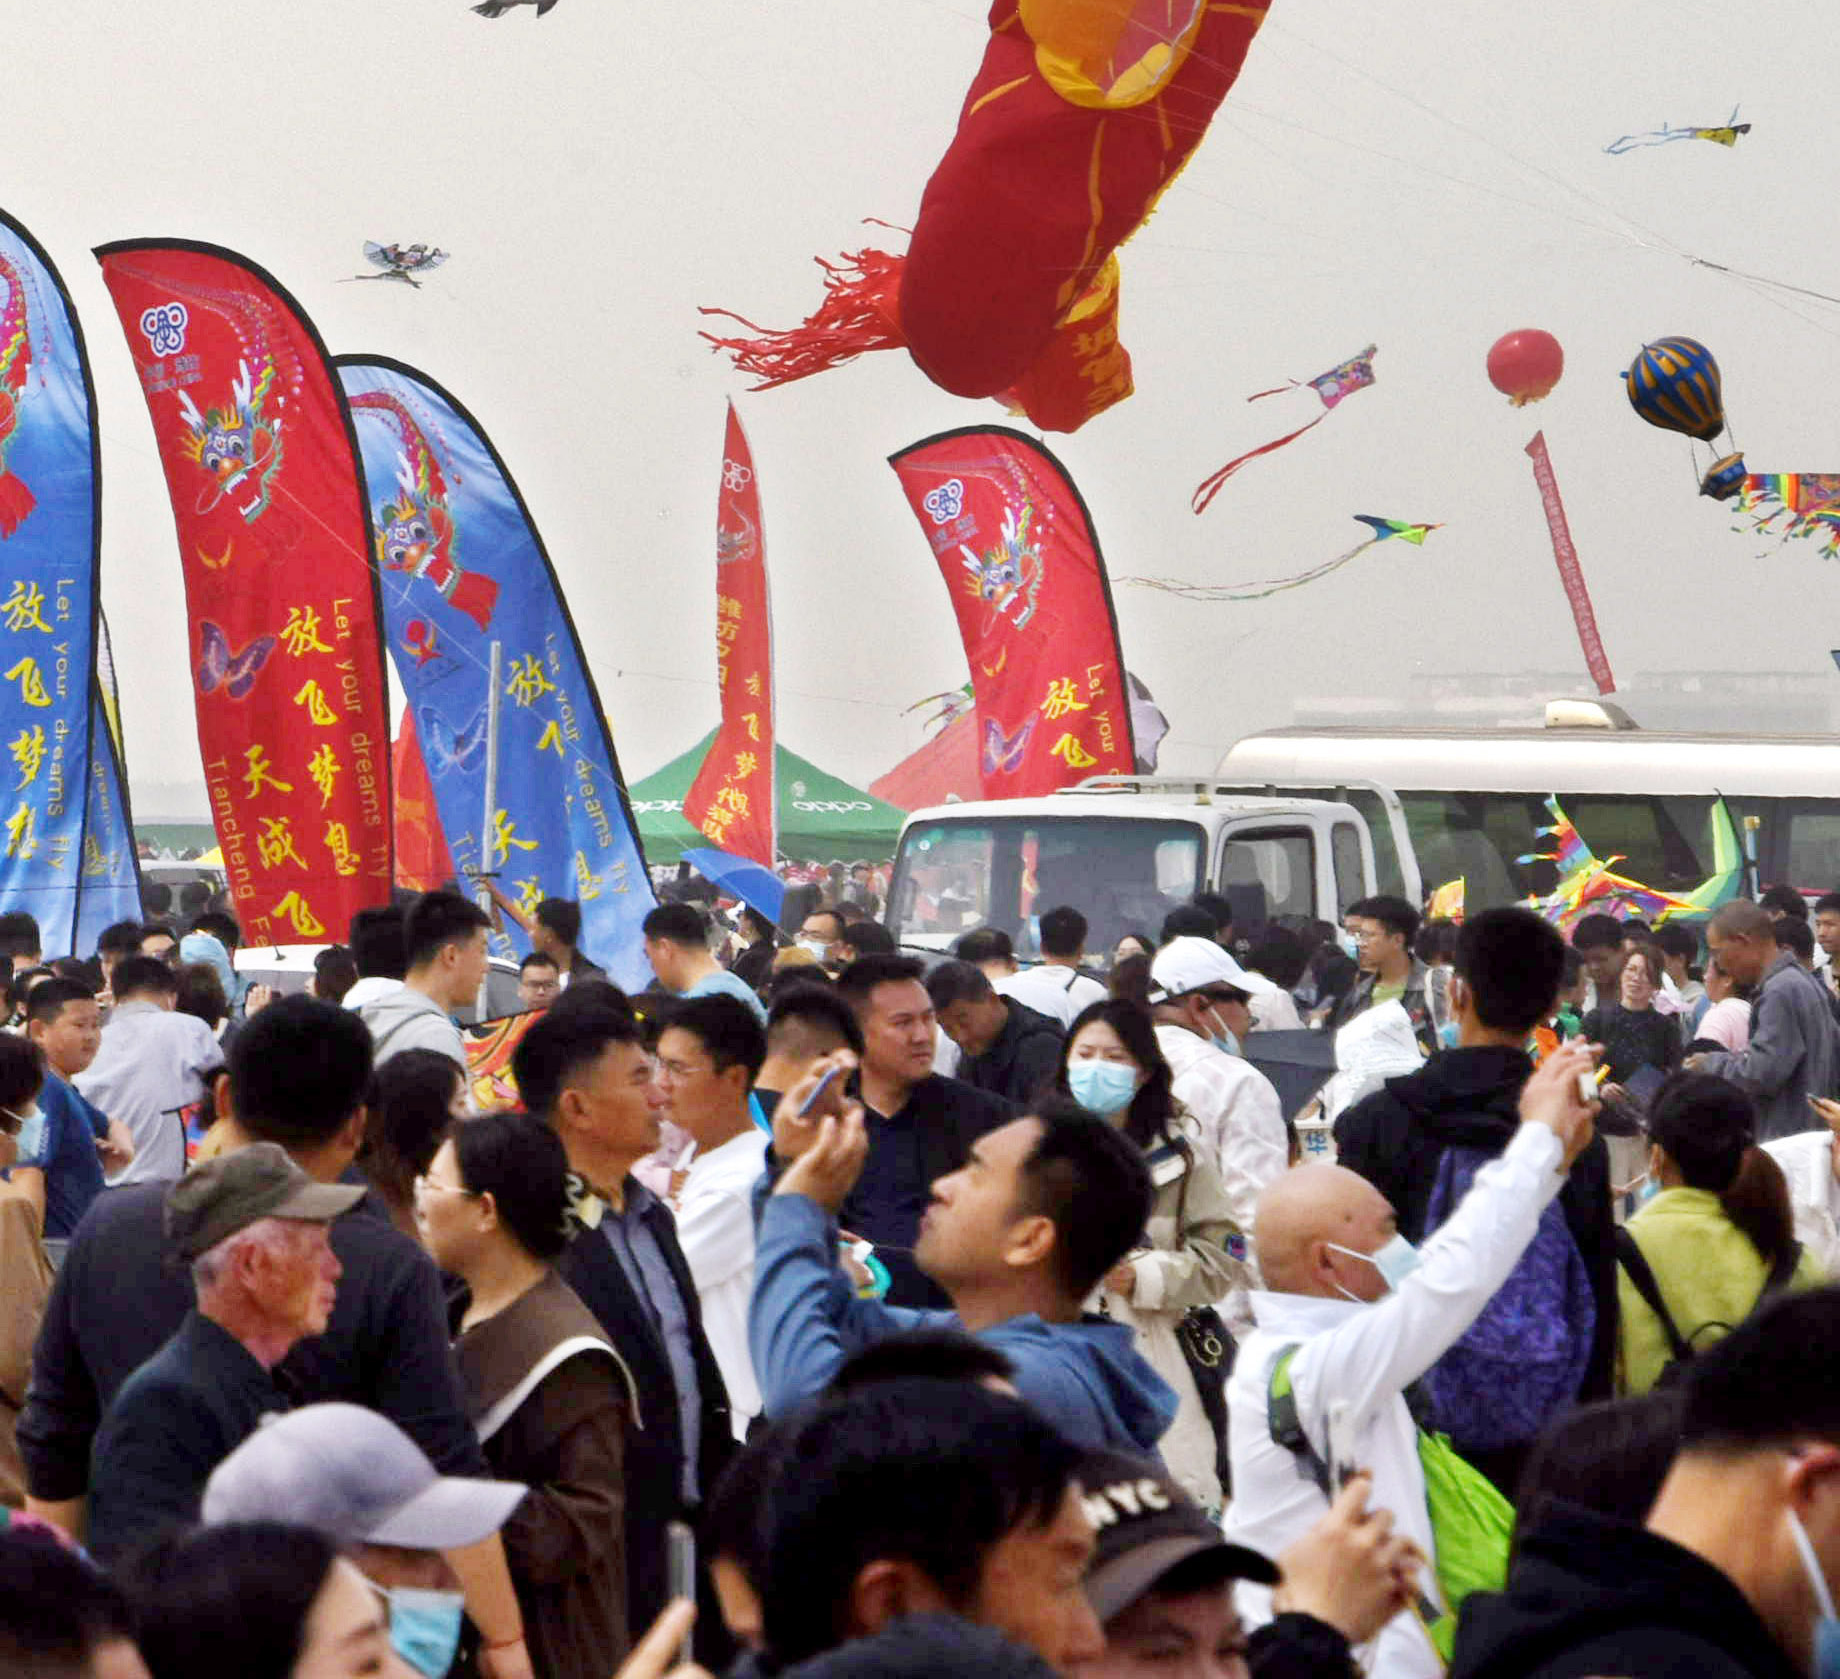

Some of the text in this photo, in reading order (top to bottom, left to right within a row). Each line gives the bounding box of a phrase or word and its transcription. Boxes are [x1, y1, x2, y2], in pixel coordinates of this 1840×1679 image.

[333, 598, 353, 639] Let
[47, 579, 74, 870] Let your dreams fly
[335, 659, 363, 713] your
[1086, 663, 1116, 755] Let your
[351, 732, 381, 829] dreams
[574, 759, 615, 849] dreams
[206, 758, 256, 900] Tiancheng
